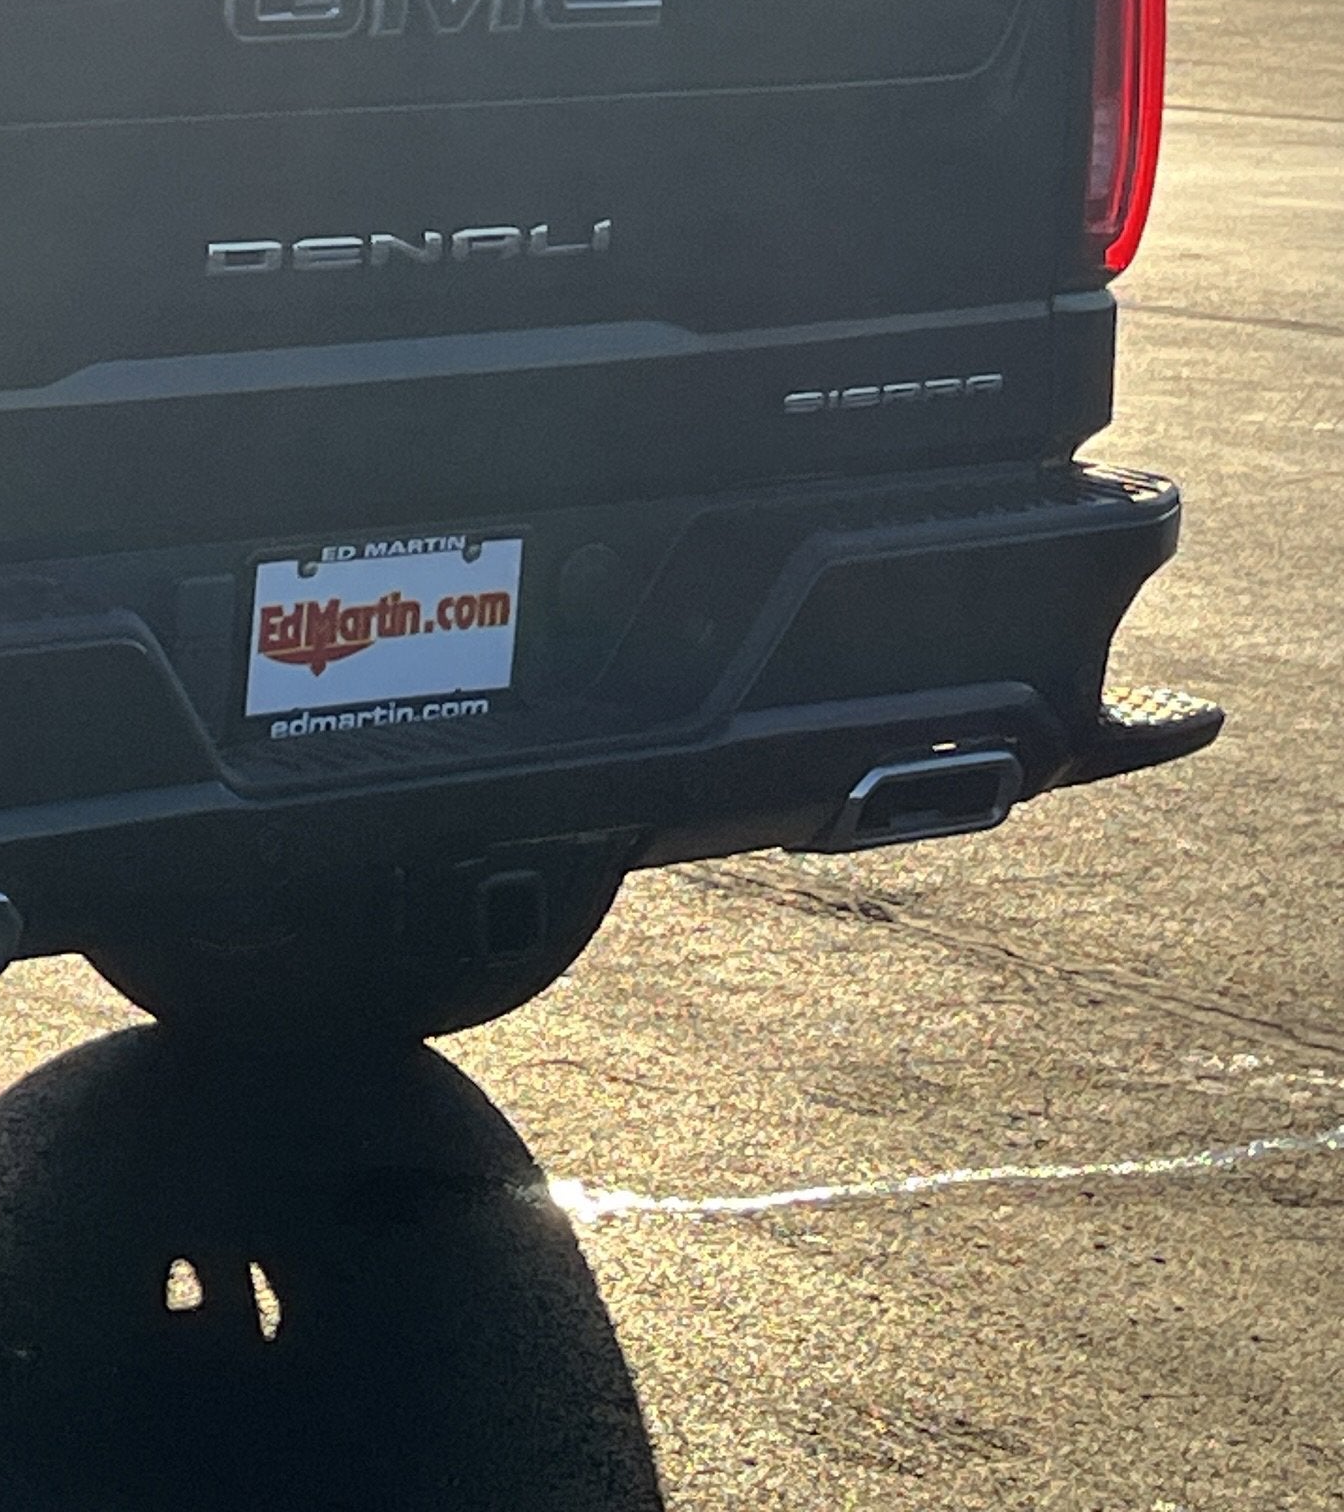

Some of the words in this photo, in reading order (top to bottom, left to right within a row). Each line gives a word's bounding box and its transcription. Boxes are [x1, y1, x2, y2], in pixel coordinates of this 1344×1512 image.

[207, 218, 612, 276] DENALI
[783, 373, 1003, 414] SIERRA
[321, 544, 357, 563] ED
[364, 534, 467, 559] MARTIN
[257, 590, 511, 656] EdMartin.com
[270, 698, 490, 740] edmartin.com
